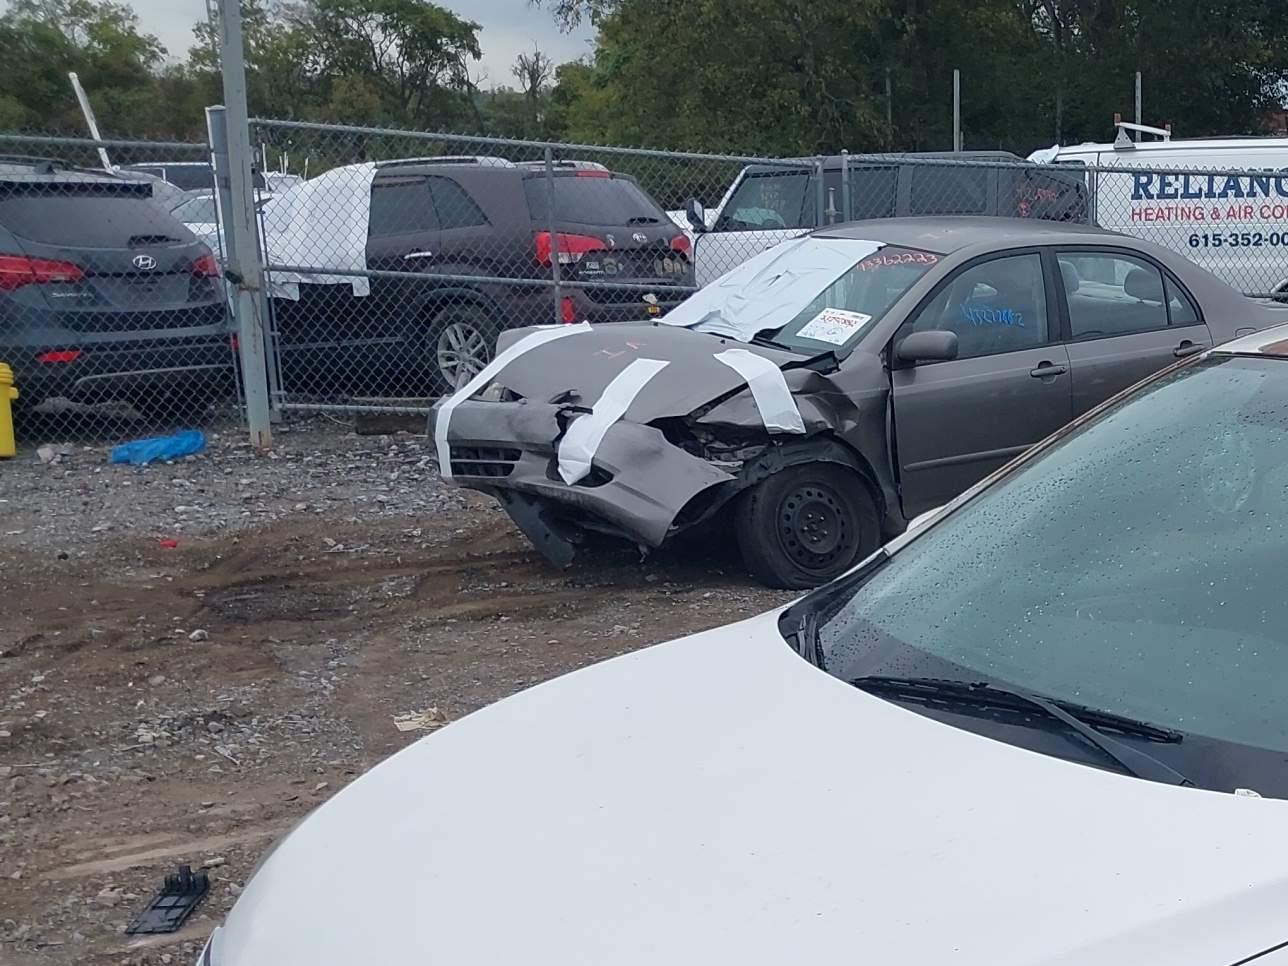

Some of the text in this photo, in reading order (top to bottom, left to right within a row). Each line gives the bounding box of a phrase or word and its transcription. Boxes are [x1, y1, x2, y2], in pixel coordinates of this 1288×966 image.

[1131, 206, 1205, 222] HEATING
[1210, 207, 1221, 220] &
[1226, 205, 1254, 220] AIR
